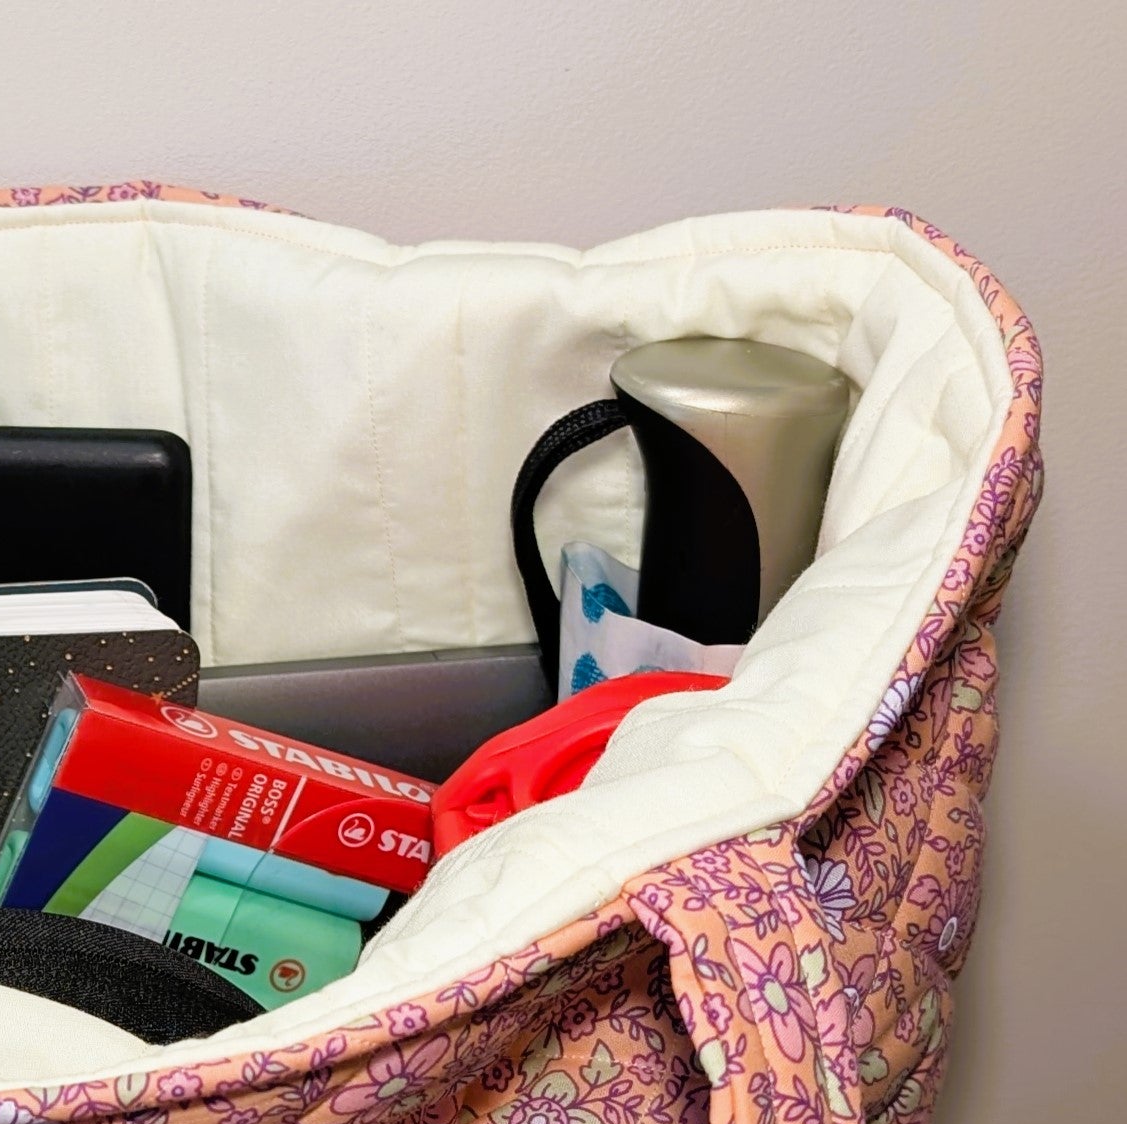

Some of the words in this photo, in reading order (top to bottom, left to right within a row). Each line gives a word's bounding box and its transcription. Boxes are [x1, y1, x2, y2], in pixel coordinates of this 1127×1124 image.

[228, 729, 431, 803] STABILO
[179, 772, 207, 818] Surligneur
[193, 777, 222, 826] Highlighter
[209, 783, 238, 831] Textmarker
[228, 773, 268, 838] ORIGINAL
